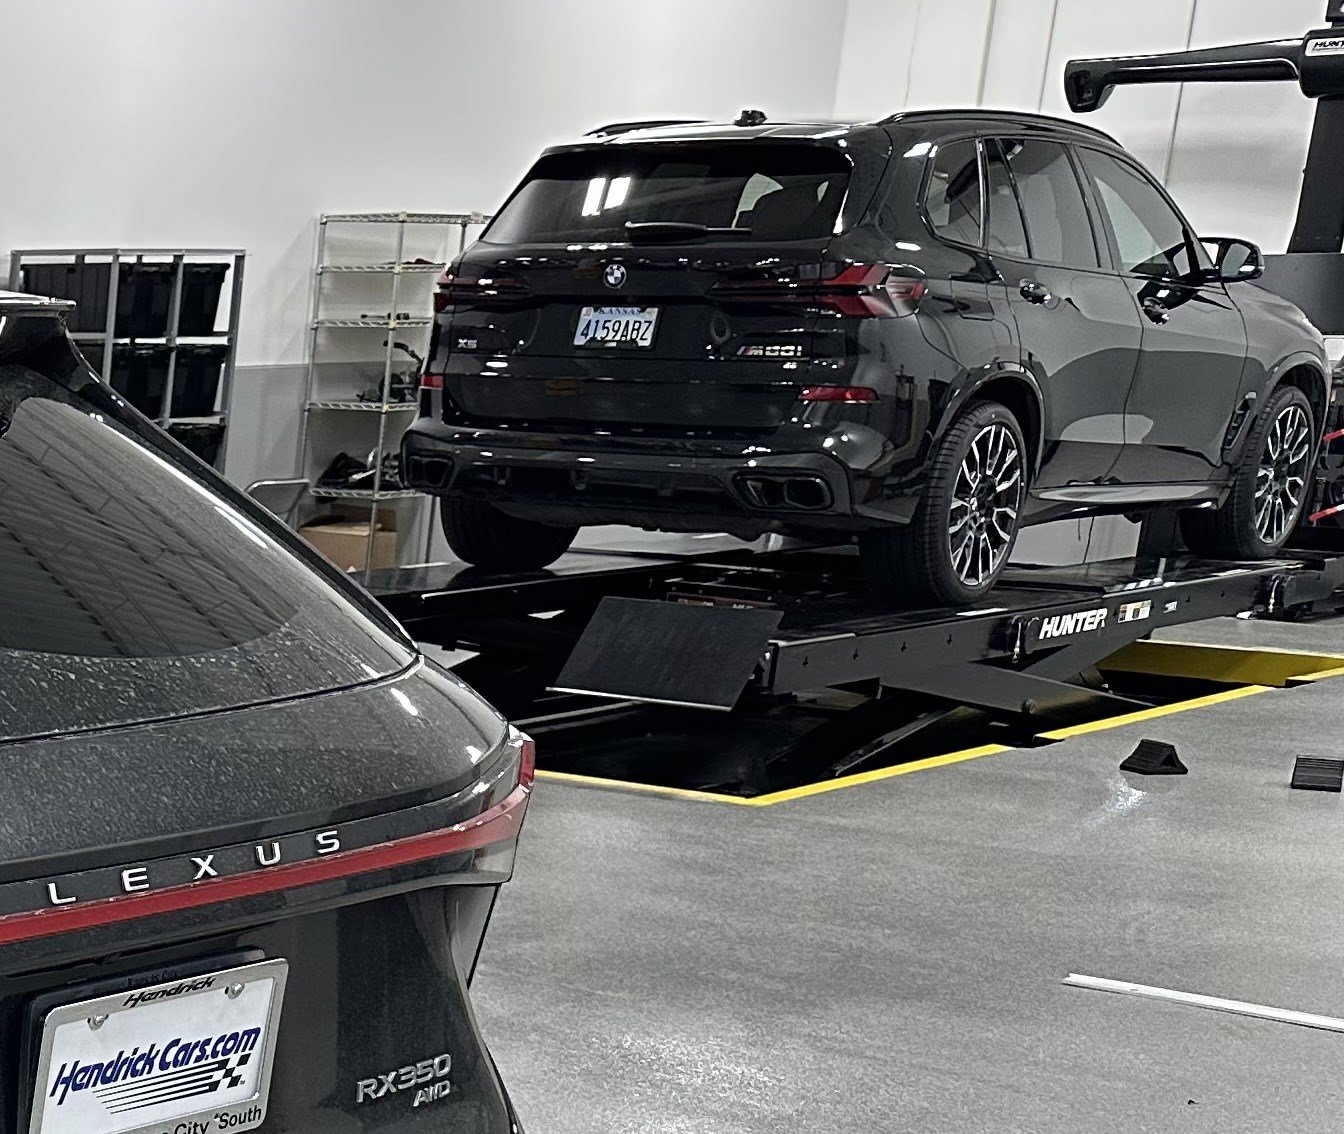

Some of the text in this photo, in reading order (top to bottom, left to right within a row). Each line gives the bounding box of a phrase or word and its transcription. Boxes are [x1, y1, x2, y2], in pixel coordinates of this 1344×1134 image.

[457, 338, 478, 349] X5
[579, 319, 654, 341] 4159ABZ
[1038, 607, 1109, 640] HUNTER
[47, 830, 342, 906] LEXUS
[121, 976, 217, 1009] Hendrick
[355, 1053, 452, 1103] RX350
[412, 1079, 451, 1107] AWD
[218, 1103, 263, 1131] South
